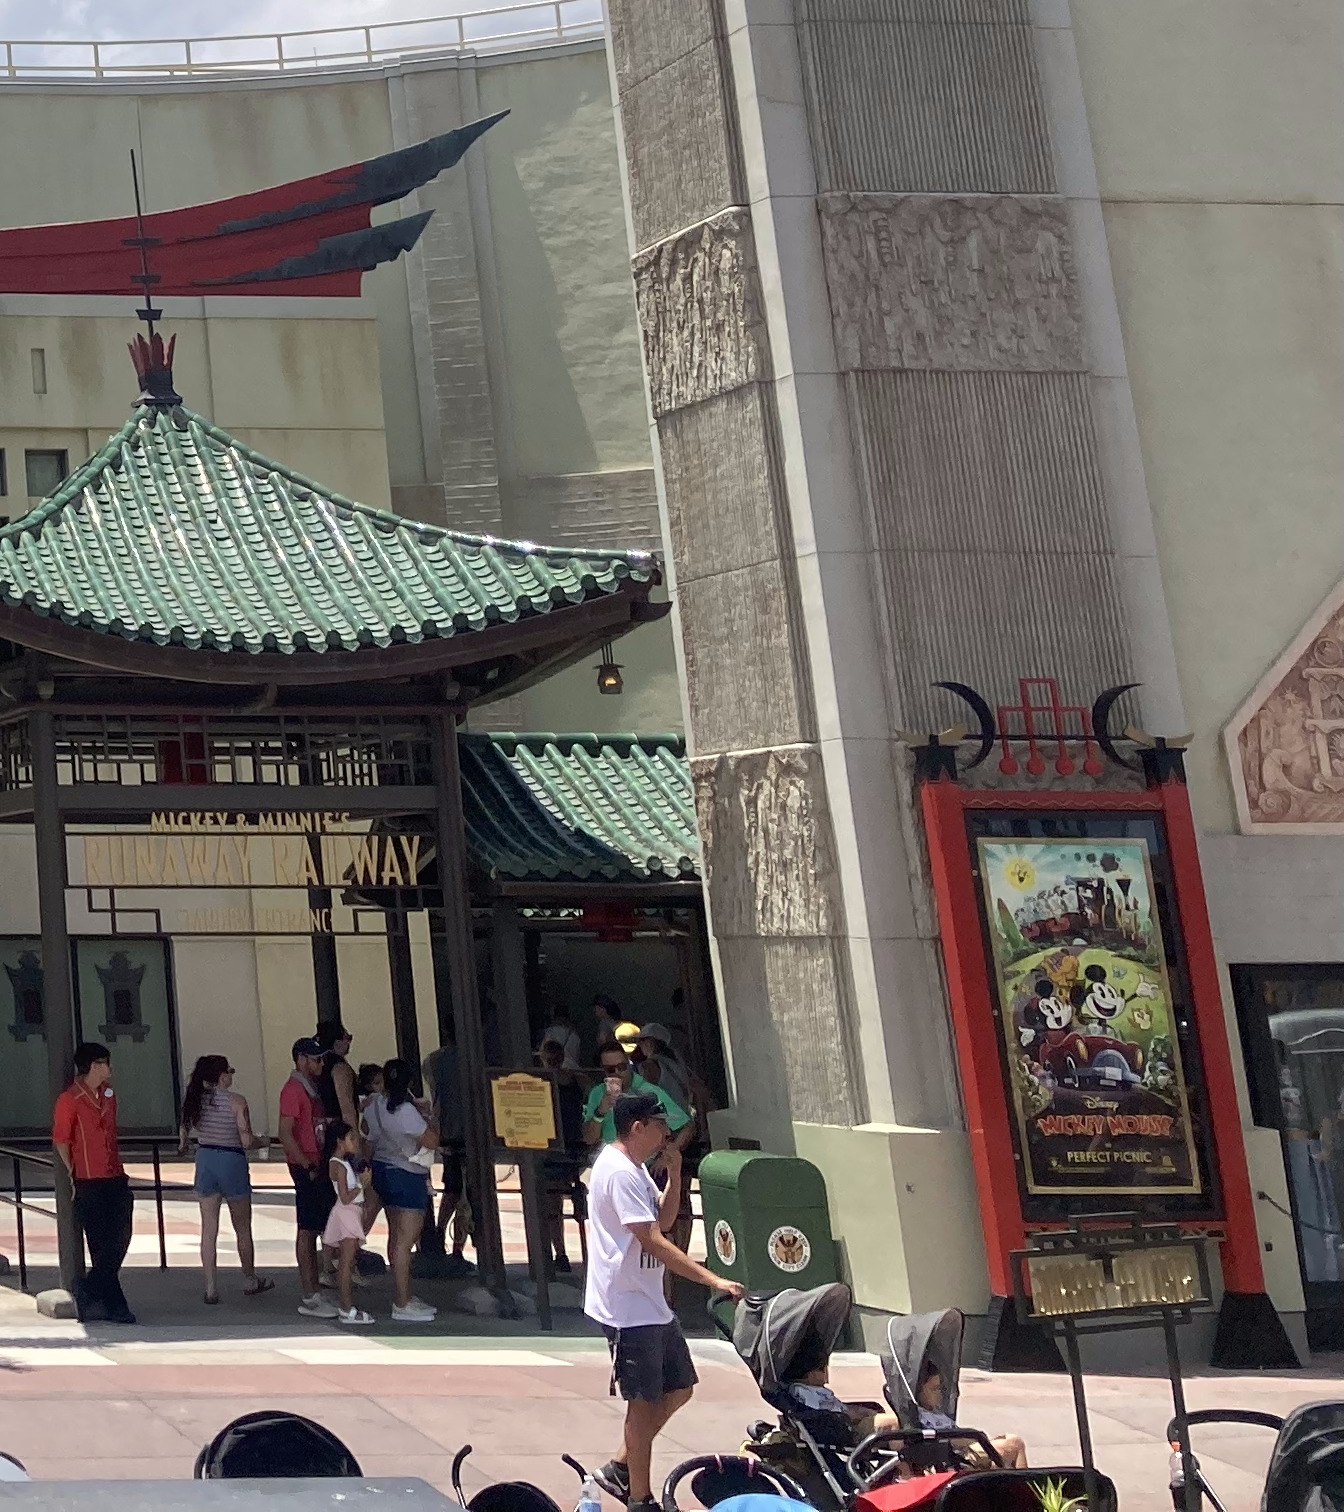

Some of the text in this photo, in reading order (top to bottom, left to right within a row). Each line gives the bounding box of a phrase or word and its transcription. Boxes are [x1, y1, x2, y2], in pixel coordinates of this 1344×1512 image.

[150, 811, 350, 832] MICKEY & MINNIE'S
[85, 835, 419, 886] RUNAWAY RAILWAY
[1080, 1094, 1120, 1113] Disney
[1038, 1115, 1173, 1136] MICKEY MOUSE
[1067, 1151, 1153, 1164] PERFECT PICNIC
